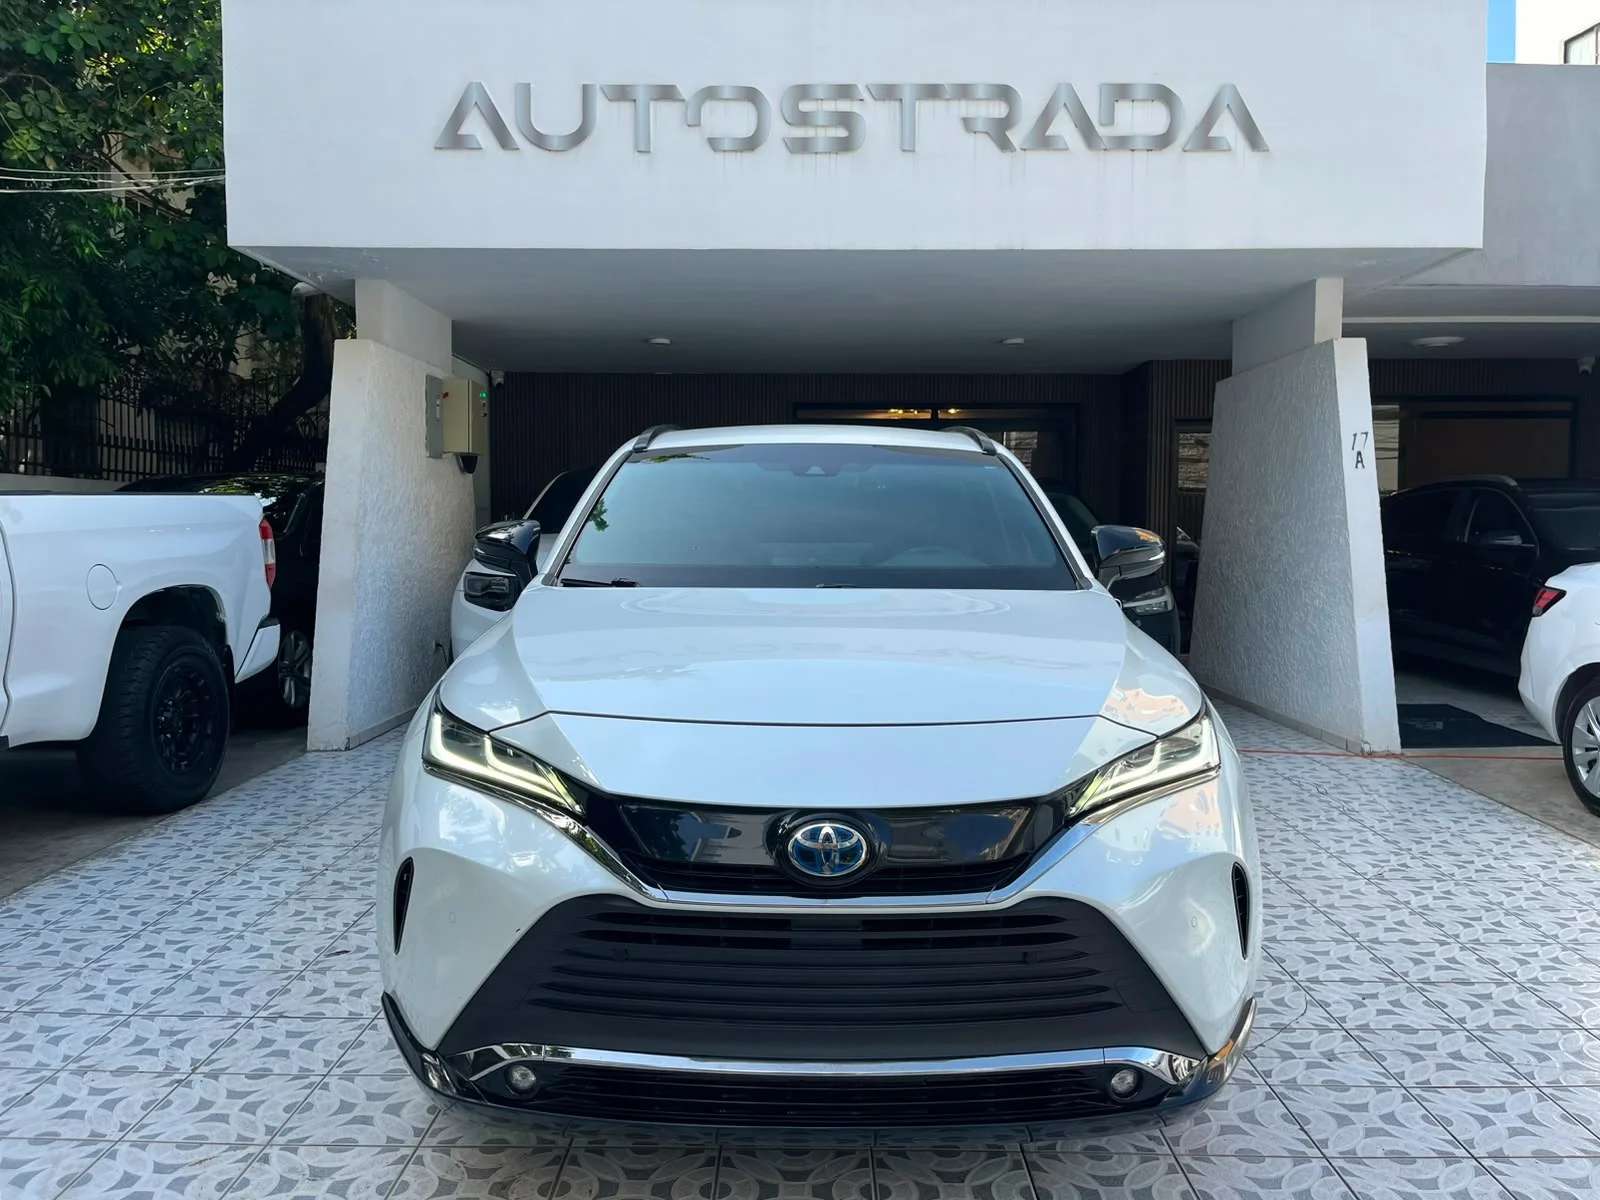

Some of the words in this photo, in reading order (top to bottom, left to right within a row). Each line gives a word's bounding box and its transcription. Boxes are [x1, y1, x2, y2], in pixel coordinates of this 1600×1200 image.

[434, 81, 1270, 154] AUTOSTRADA
[1352, 432, 1368, 451] 17
[1355, 451, 1365, 469] A
